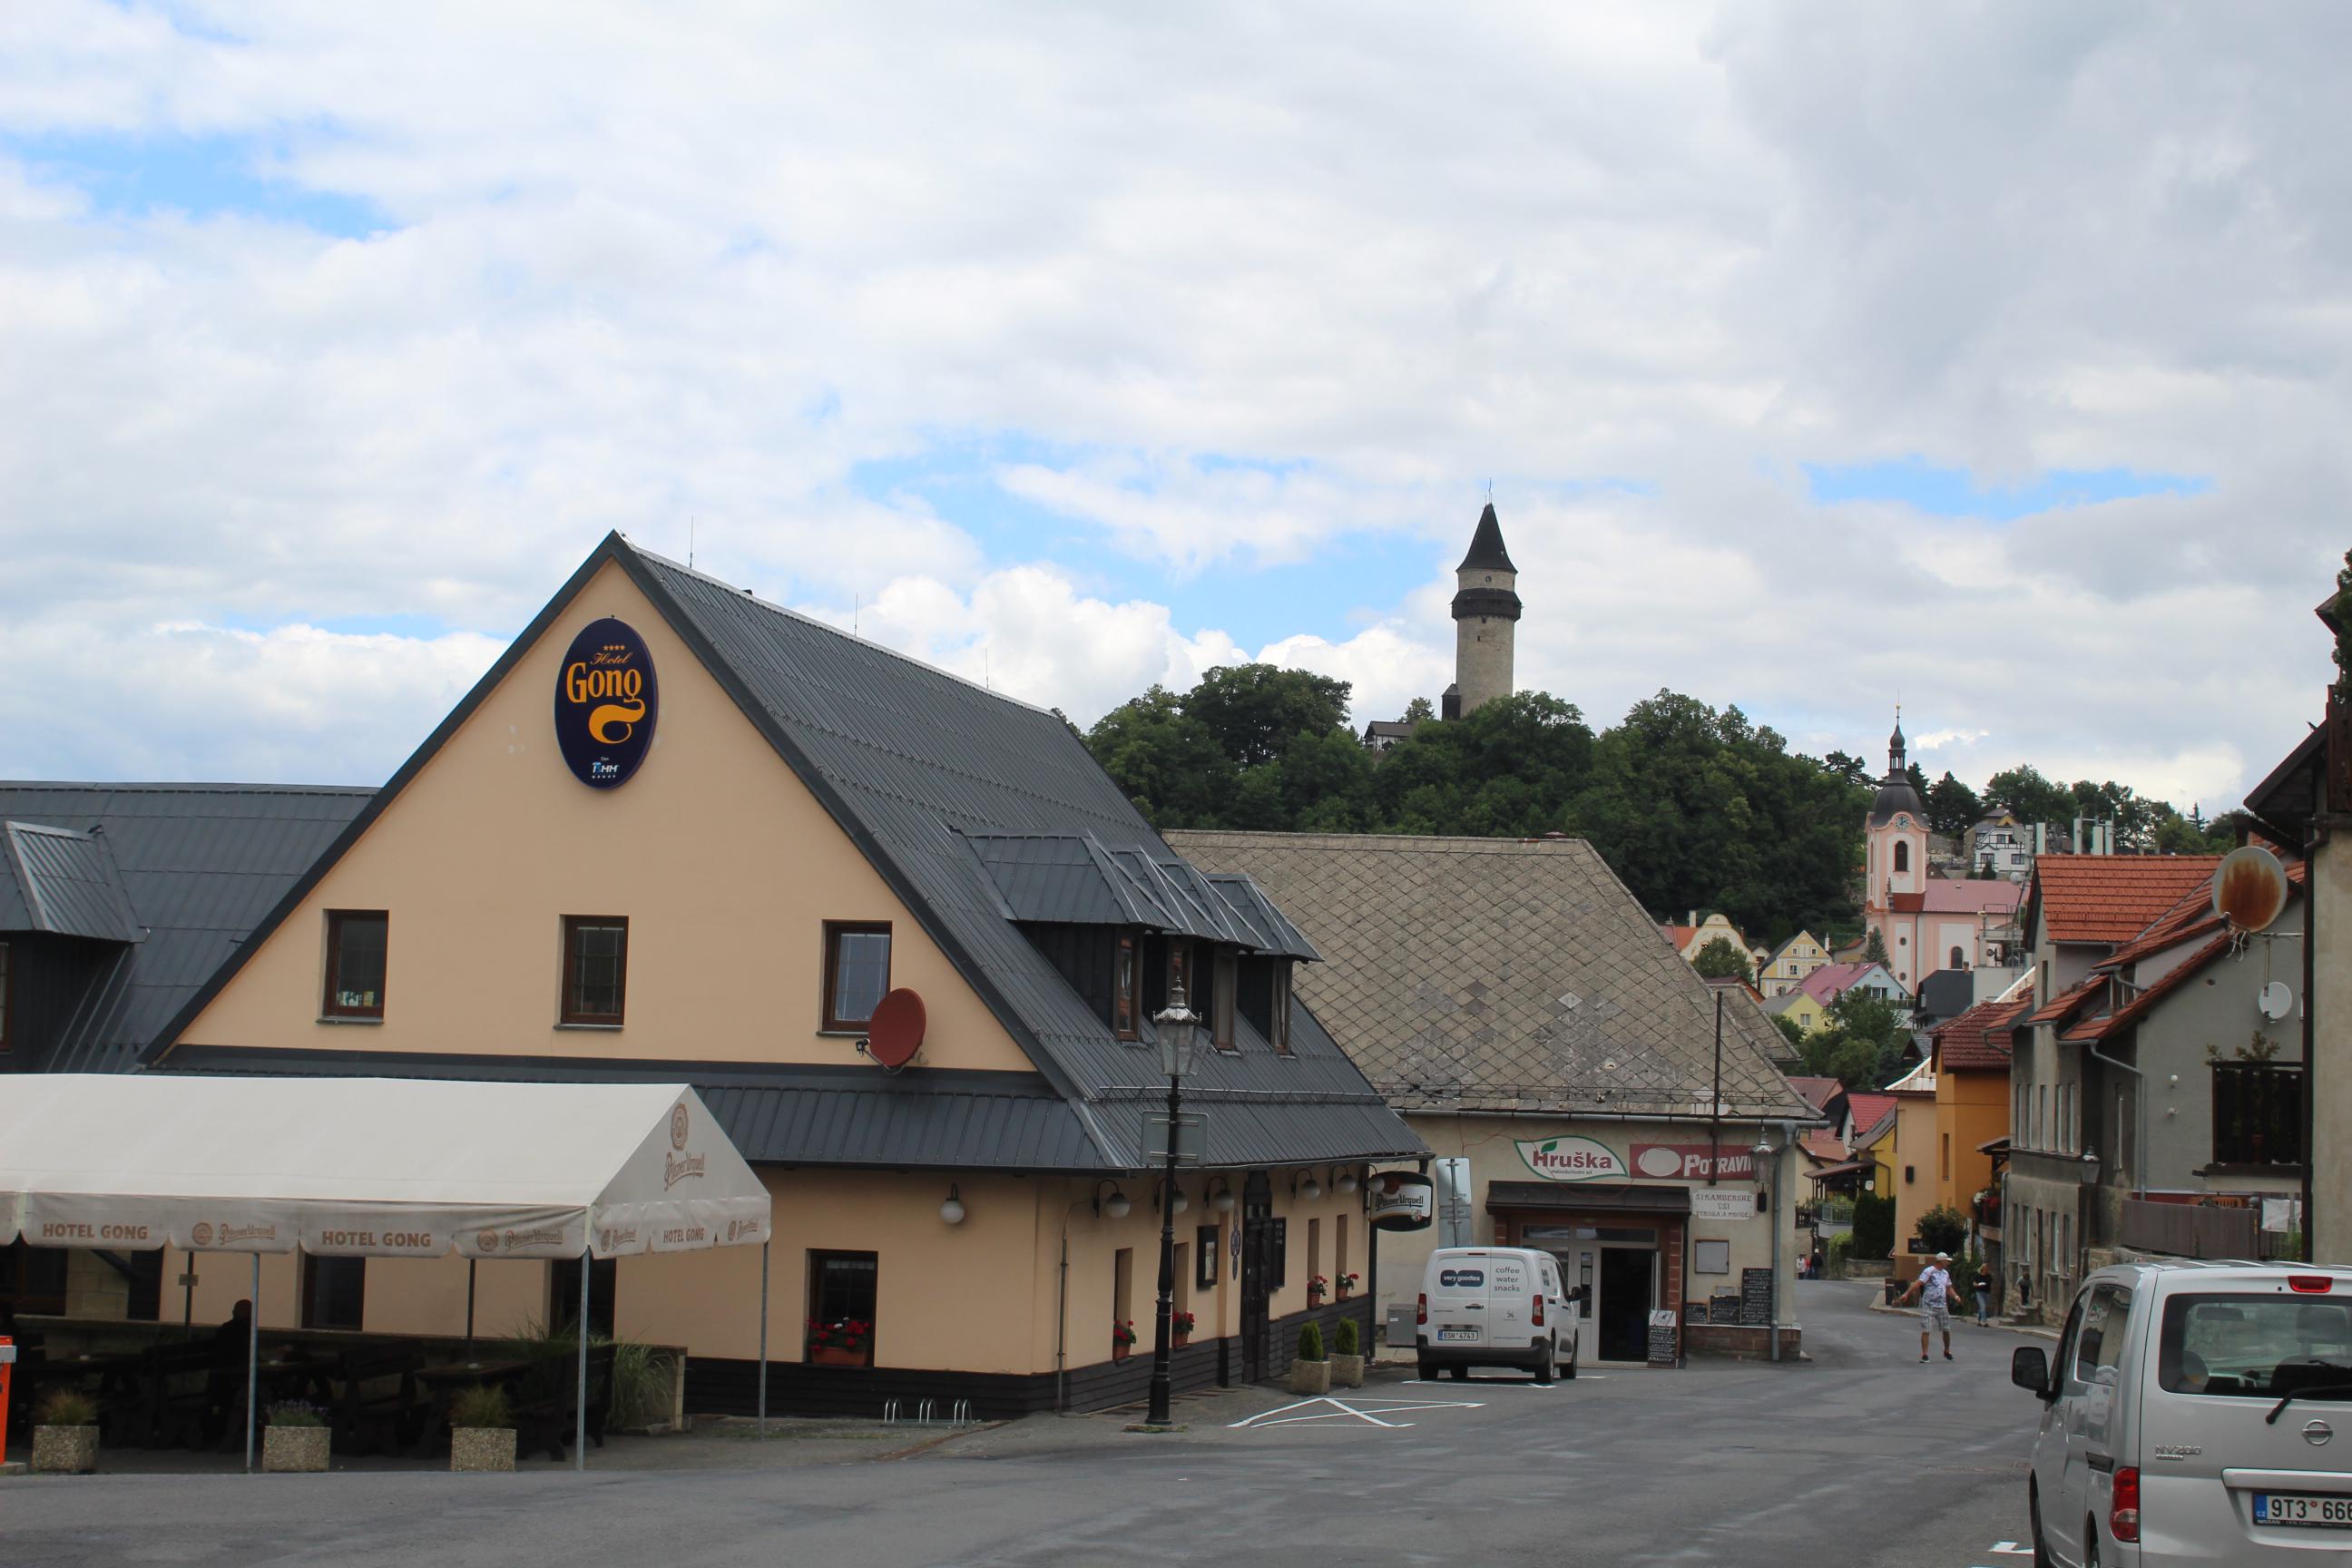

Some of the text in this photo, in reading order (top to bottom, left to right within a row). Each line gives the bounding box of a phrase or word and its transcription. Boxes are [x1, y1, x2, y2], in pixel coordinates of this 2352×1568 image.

[590, 652, 633, 665] Hotel
[566, 662, 646, 744] Gong
[1533, 1150, 1612, 1169] Hruška
[1399, 1194, 1424, 1208] Urquell
[43, 1224, 148, 1240] HOTEL GONG
[321, 1231, 431, 1247] HOTEL GONG
[663, 1228, 704, 1243] HOTEL GONG
[1495, 1266, 1520, 1274] coffee
[1494, 1284, 1520, 1292] snacks
[2271, 1499, 2307, 1519] 9T3
